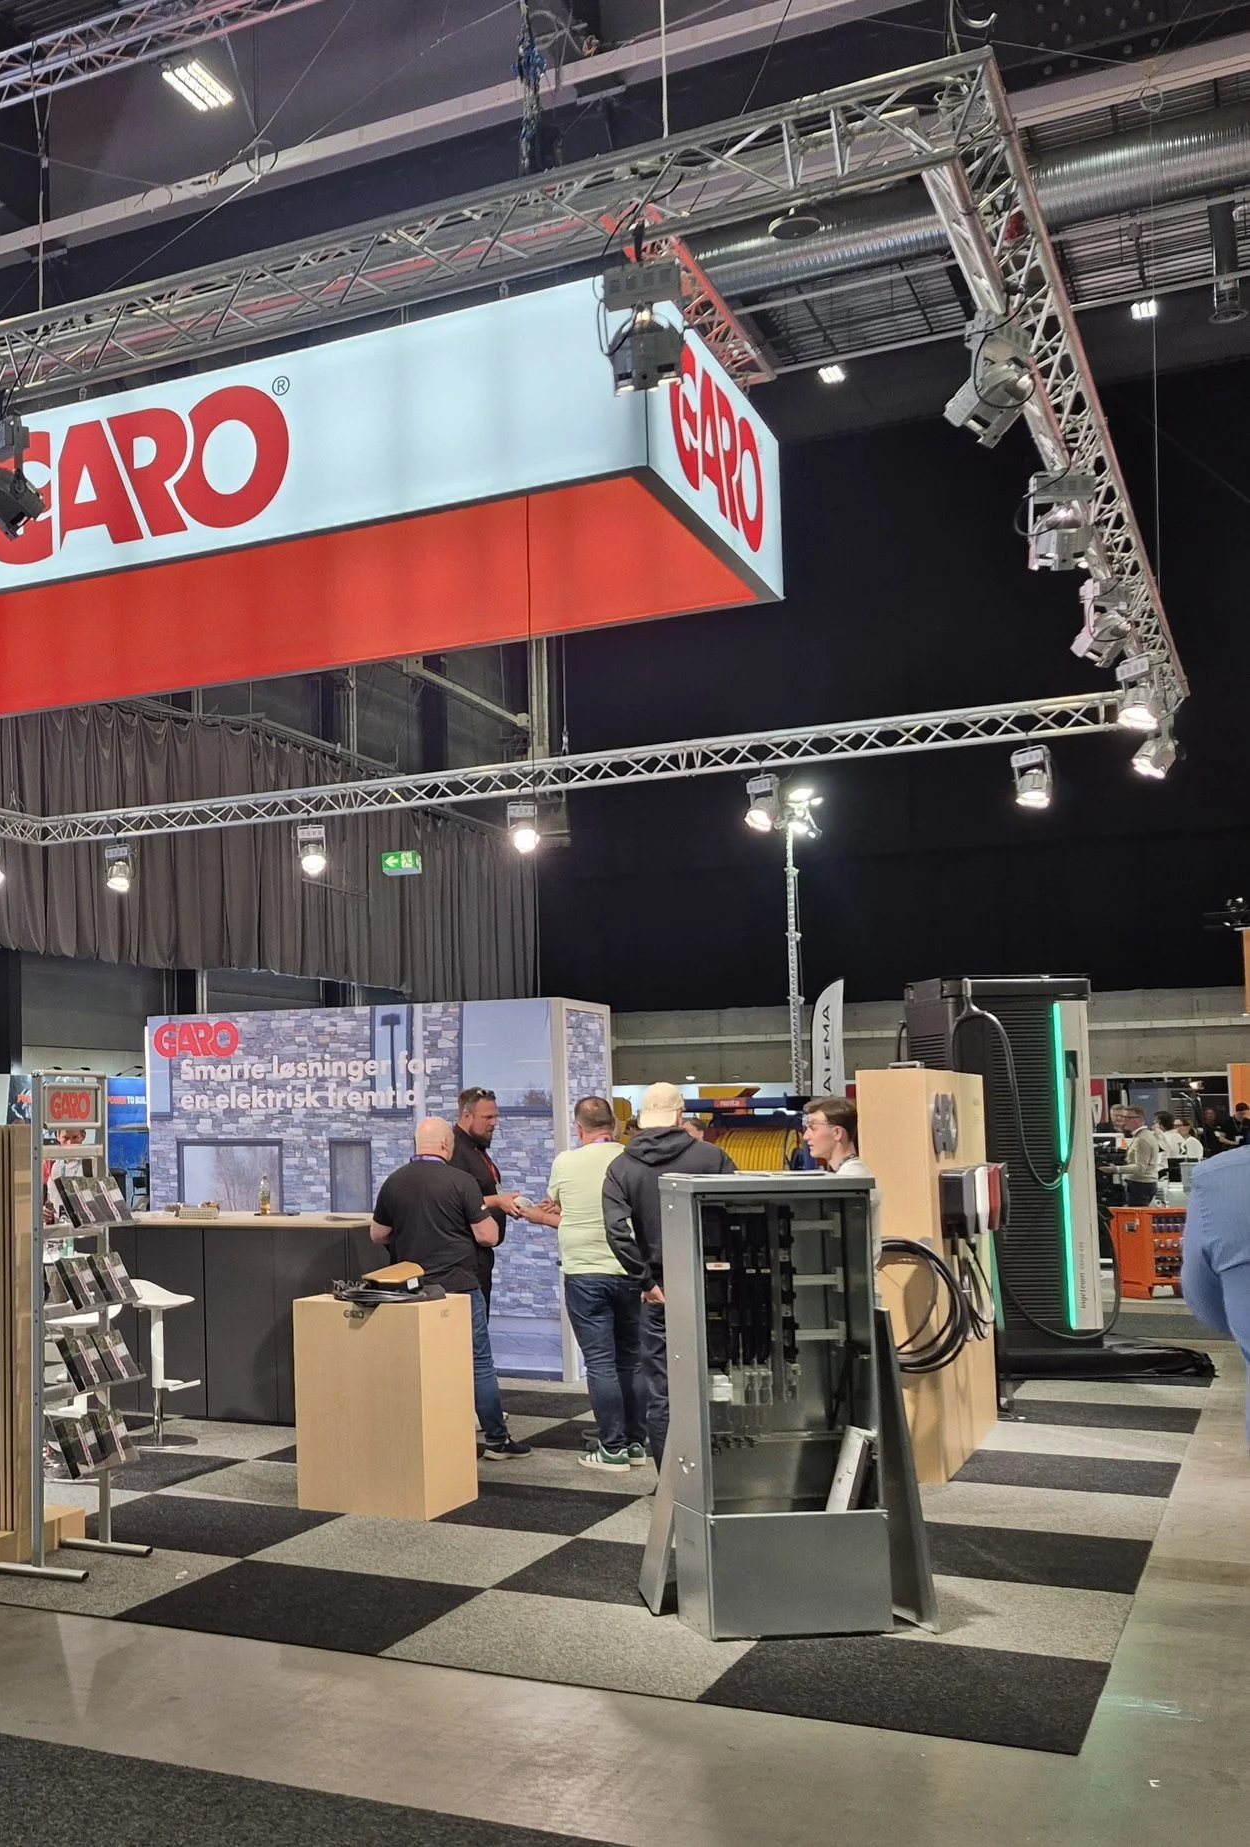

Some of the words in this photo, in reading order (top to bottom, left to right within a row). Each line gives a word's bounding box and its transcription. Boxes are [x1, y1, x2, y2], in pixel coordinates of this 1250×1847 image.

[669, 342, 764, 553] GARO
[153, 1021, 239, 1058] GARO
[181, 1059, 265, 1081] Smarte
[272, 1054, 390, 1083] løsninger
[398, 1050, 438, 1075] for
[50, 1091, 91, 1120] GARO
[135, 1095, 147, 1104] BUIL
[181, 1089, 211, 1110] en
[216, 1086, 322, 1110] elektrisk
[327, 1081, 422, 1107] fremtid
